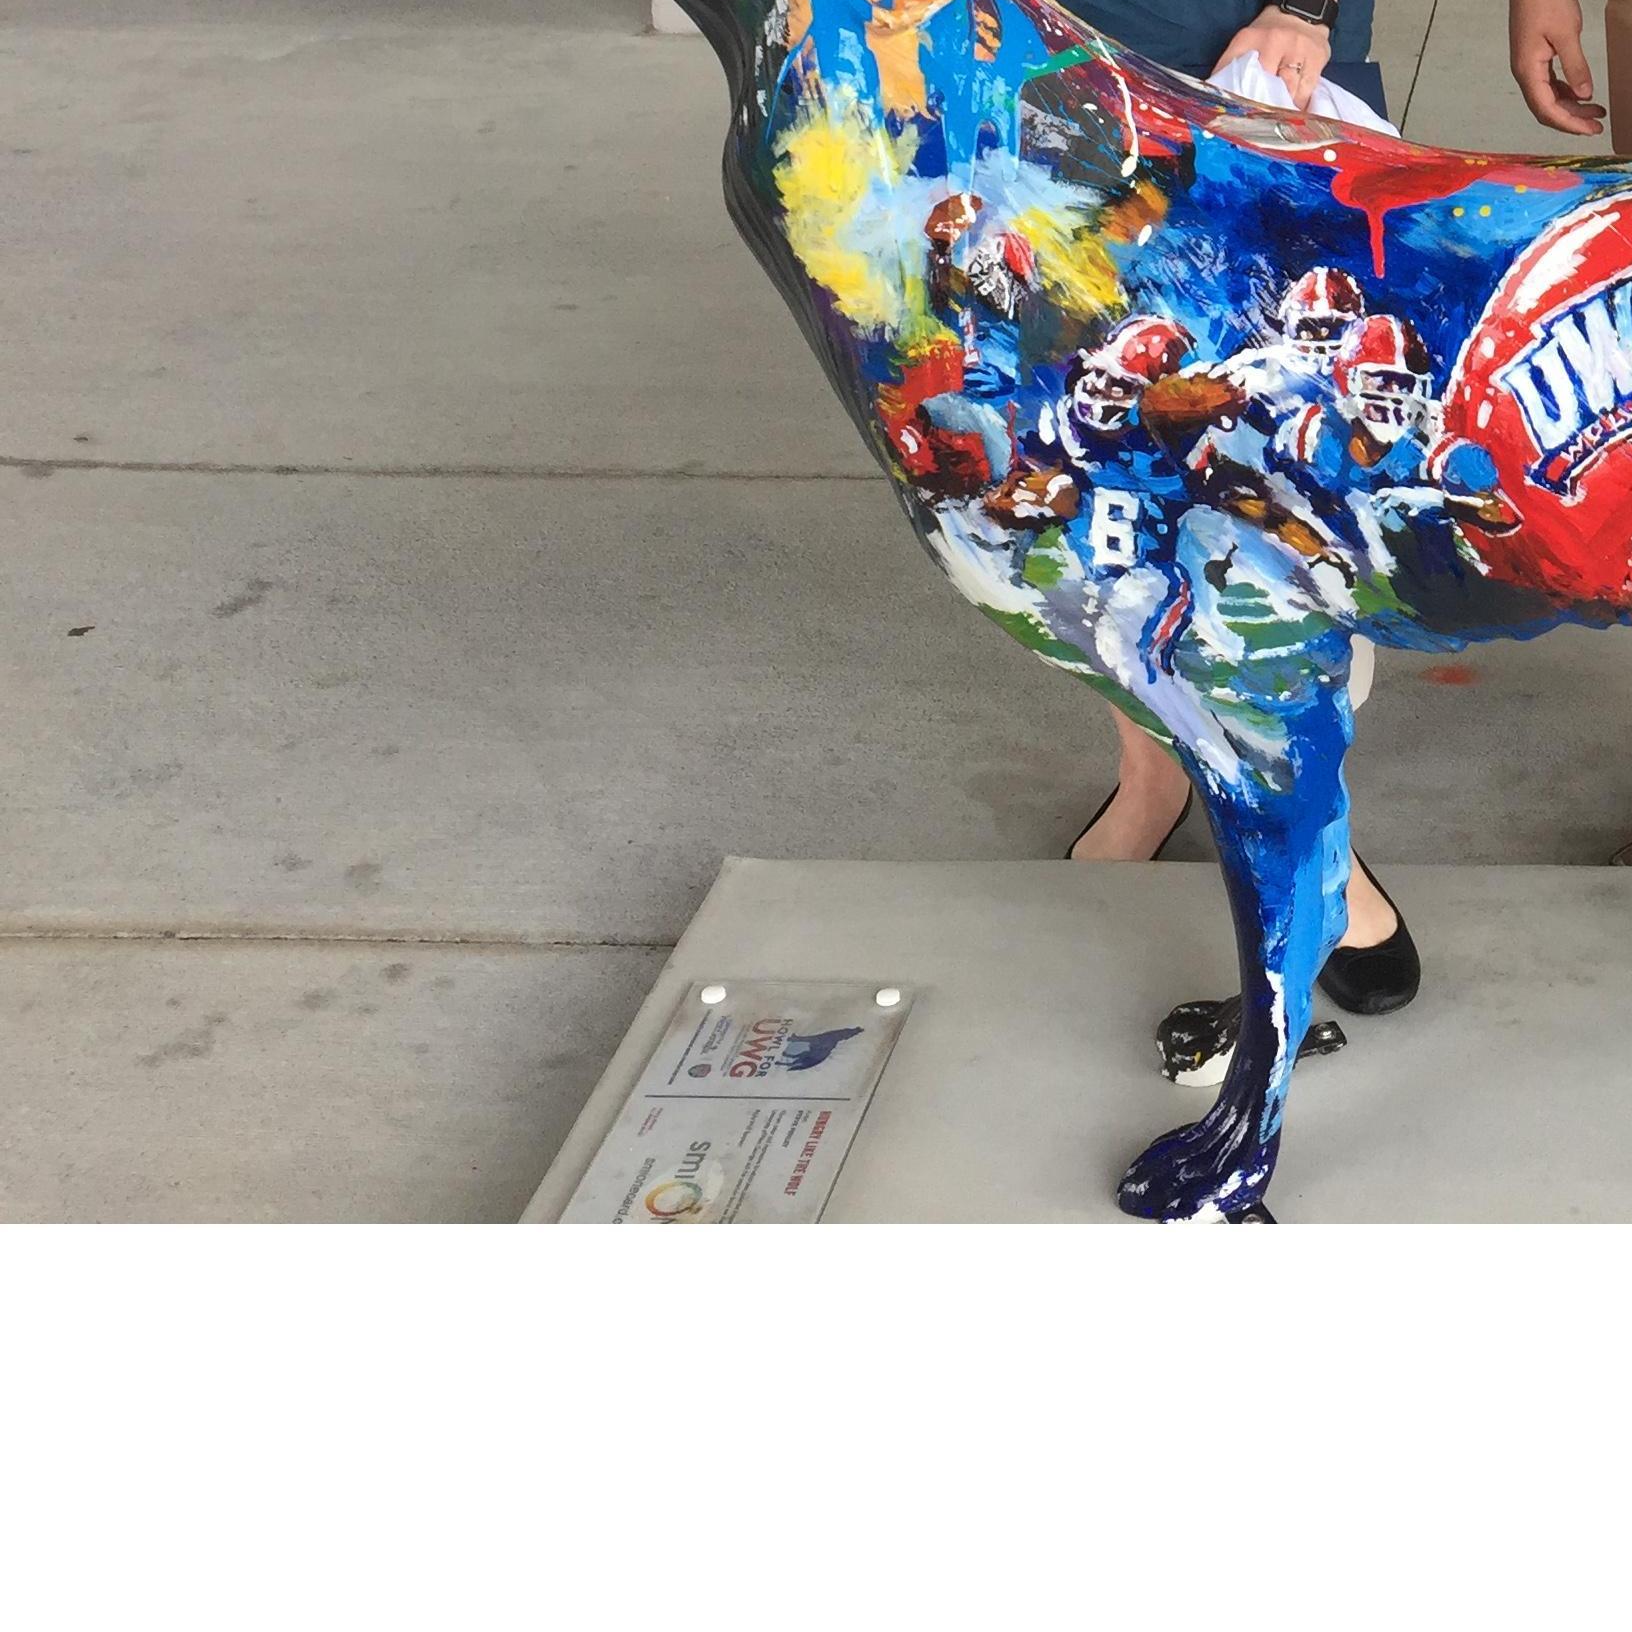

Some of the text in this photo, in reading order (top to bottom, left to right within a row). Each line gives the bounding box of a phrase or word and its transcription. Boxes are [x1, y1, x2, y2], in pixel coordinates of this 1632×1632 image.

[729, 1018, 782, 1078] UWG
[754, 1019, 794, 1078] HOWL FOR
